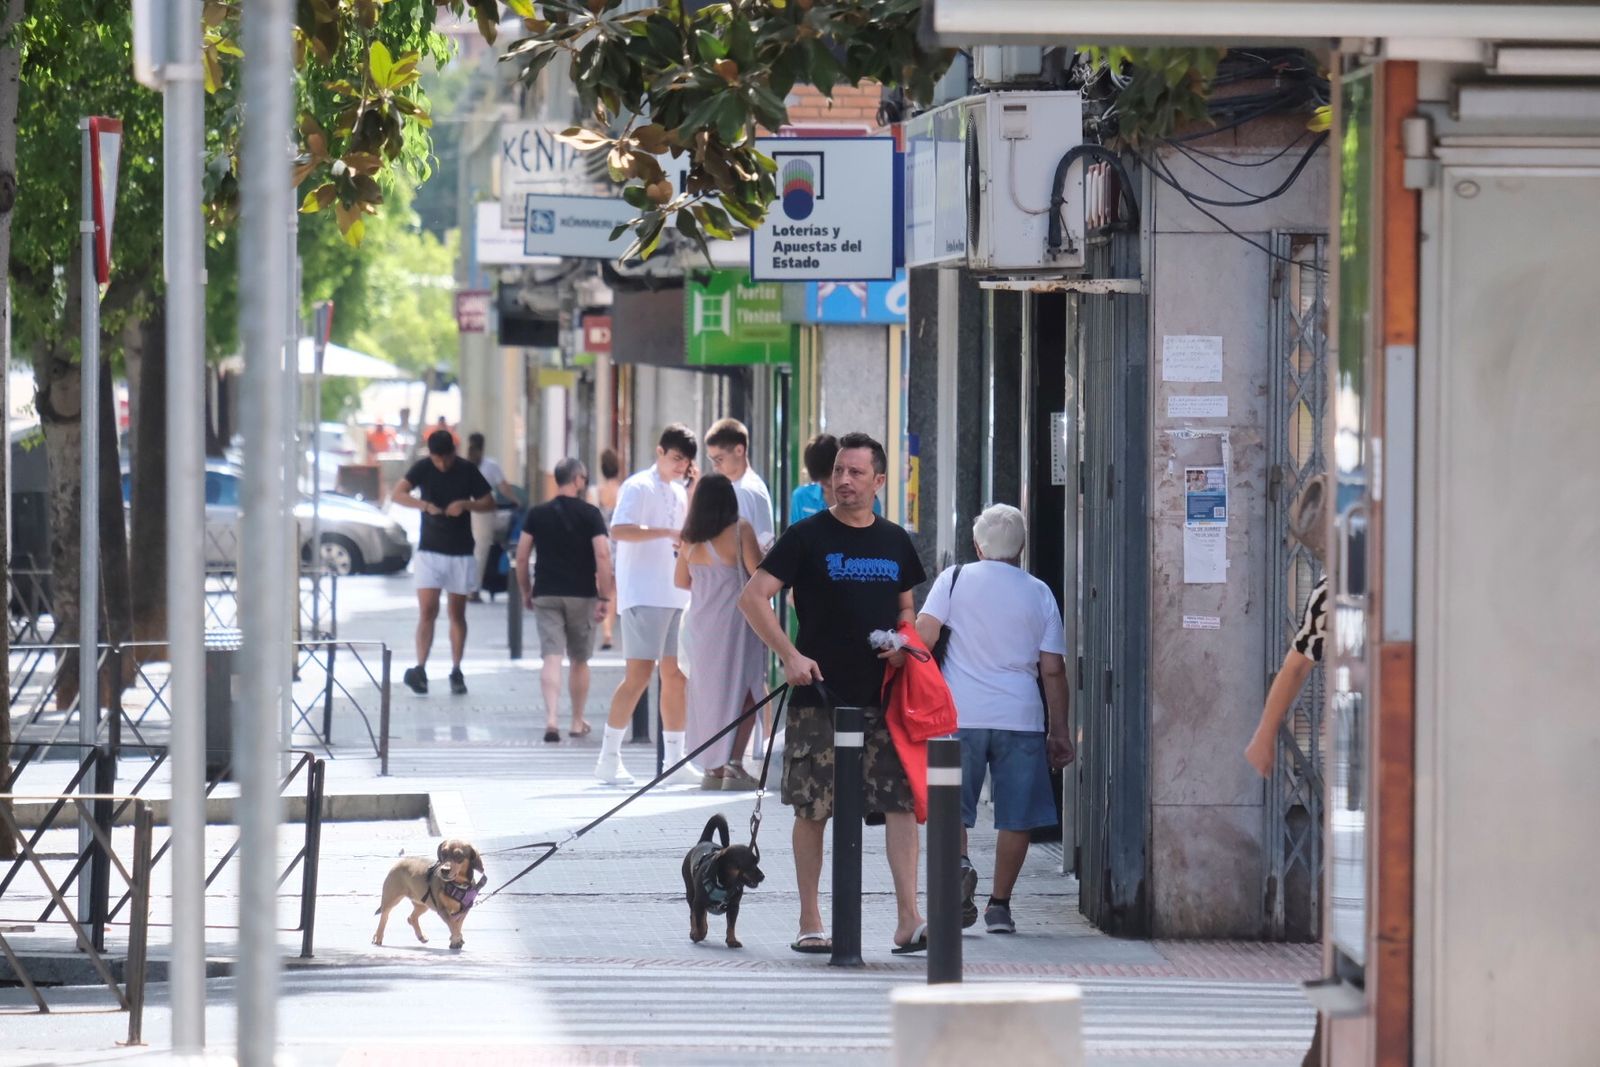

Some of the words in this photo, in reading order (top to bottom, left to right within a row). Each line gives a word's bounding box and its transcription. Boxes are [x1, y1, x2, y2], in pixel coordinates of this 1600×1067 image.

[772, 223, 829, 236] Loterías
[832, 227, 841, 239] y
[773, 241, 837, 255] Apuestas
[841, 240, 862, 252] del
[772, 256, 820, 268] Estado
